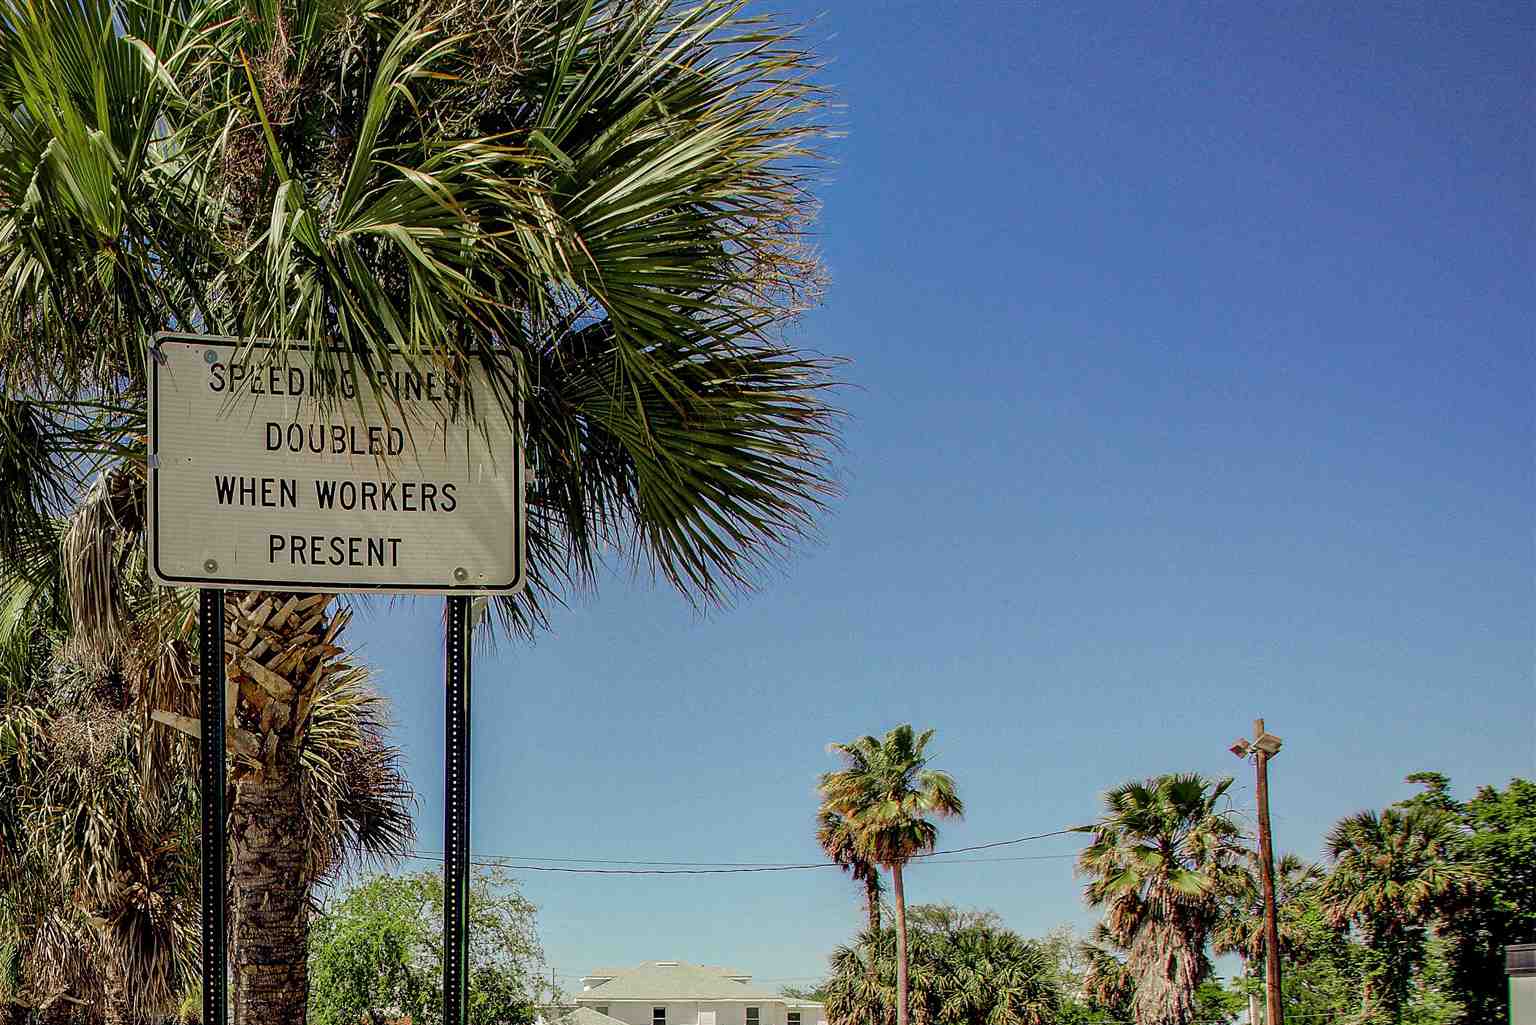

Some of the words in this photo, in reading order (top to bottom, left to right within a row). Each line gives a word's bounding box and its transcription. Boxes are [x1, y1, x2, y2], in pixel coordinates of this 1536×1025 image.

[378, 367, 462, 402] FINE
[265, 422, 405, 456] DOUBLED
[215, 475, 297, 508] WHEN
[315, 480, 457, 512] WORKERS
[269, 534, 402, 567] PRESENT
